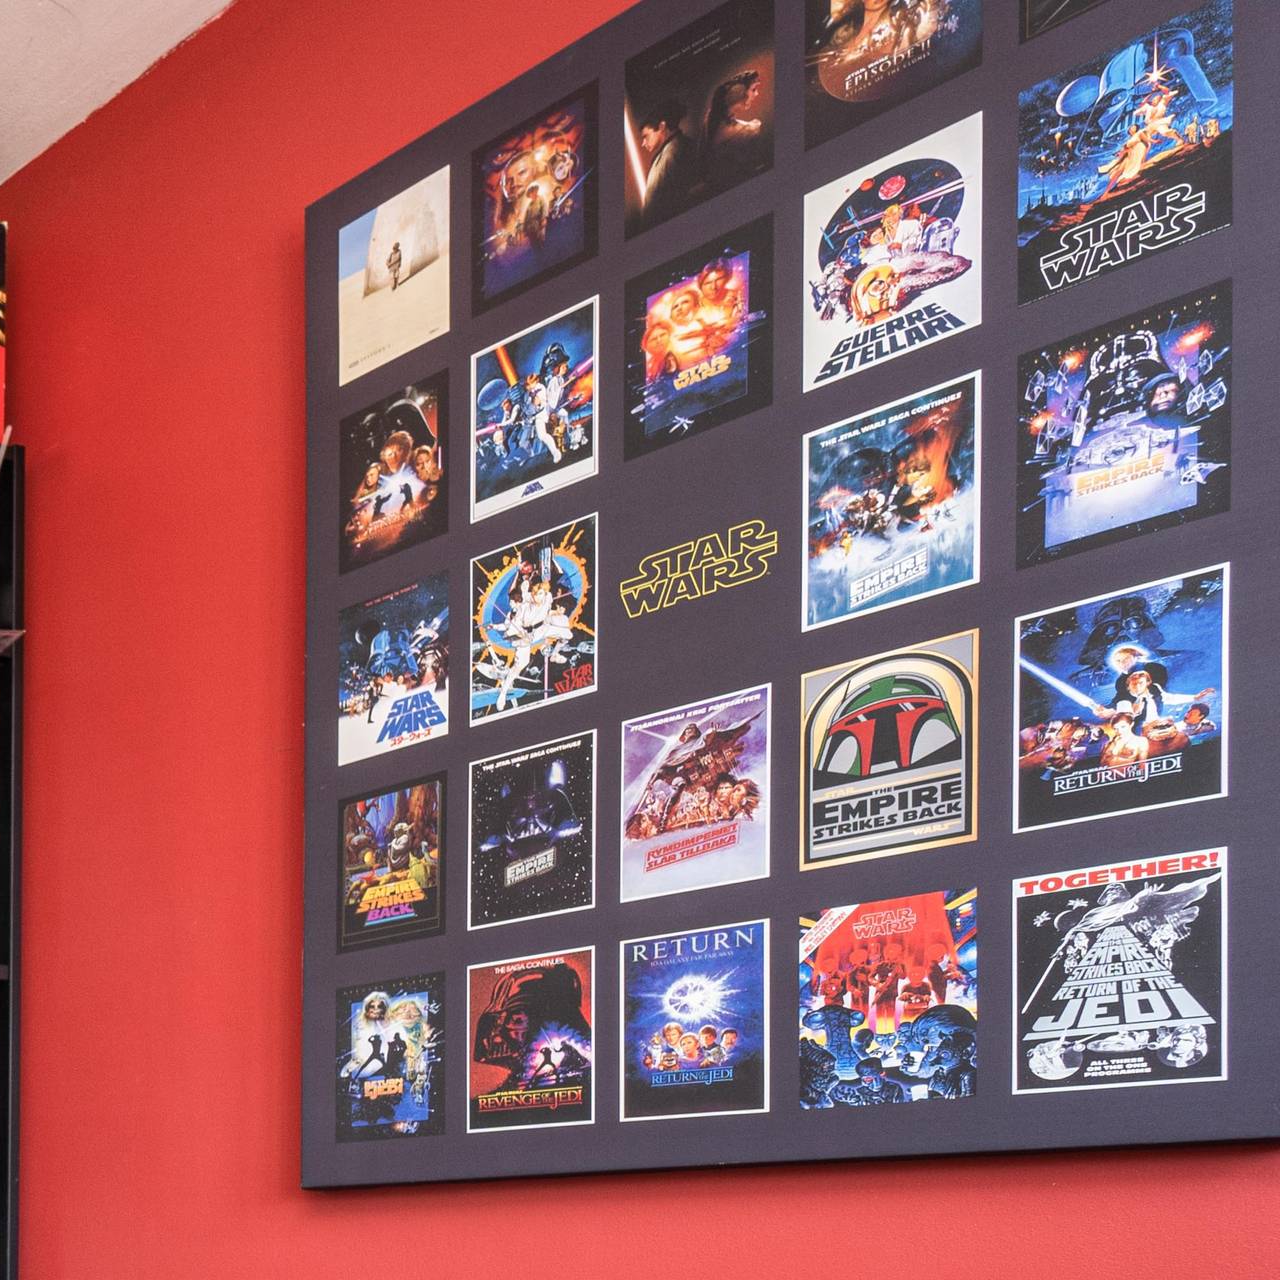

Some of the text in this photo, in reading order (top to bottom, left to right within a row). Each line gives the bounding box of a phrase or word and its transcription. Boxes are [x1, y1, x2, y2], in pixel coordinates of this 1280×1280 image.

[845, 39, 930, 90] EPISODE II
[1040, 183, 1206, 267] STAR
[1040, 202, 1206, 290] WARS
[1130, 294, 1217, 330] EDITION
[830, 302, 947, 358] GUERRE
[813, 313, 967, 384] STELLARI
[678, 354, 732, 380] STAR
[820, 391, 962, 448] THE STAR WARS SAGA CONTINUES
[1077, 454, 1165, 490] EMPIRE
[620, 519, 778, 593] STAR
[620, 543, 778, 619] WARS
[850, 550, 928, 598] EMPIRE
[562, 663, 593, 681] STAR
[387, 690, 436, 720] STAR
[376, 705, 447, 744] WARS
[482, 764, 495, 772] THE
[530, 750, 546, 759] SAGA
[546, 740, 582, 755] CONTINUES
[1054, 767, 1127, 792] RETURN
[1138, 757, 1183, 783] JEDI
[813, 779, 962, 828] EMPIRE
[873, 786, 895, 796] THE
[813, 801, 962, 839] STRIKES BACK
[912, 823, 952, 836] WARS
[680, 834, 737, 859] TILLBAKA
[507, 852, 554, 880] EMPIRE
[1020, 852, 1219, 895] TOGETHER!
[356, 889, 425, 914] STRIKES
[362, 879, 422, 902] EMPIRE
[368, 903, 414, 921] BACK
[852, 908, 917, 926] STAR
[852, 918, 917, 939] WARS
[632, 927, 755, 962] RETURN
[1080, 942, 1155, 967] EMPIRE
[494, 957, 565, 975] THE SAGA CONTINUES
[1069, 958, 1168, 982] STRIKES BACK
[1052, 975, 1183, 1001] RETURN OF THE
[1032, 987, 1210, 1032] JEDI
[1084, 1067, 1152, 1078] PROGRAMME
[1110, 1057, 1145, 1065] THREE
[652, 1068, 733, 1086] RETURN JEDI
[479, 1093, 540, 1109] REVENGE
[549, 1089, 582, 1111] JEDI
